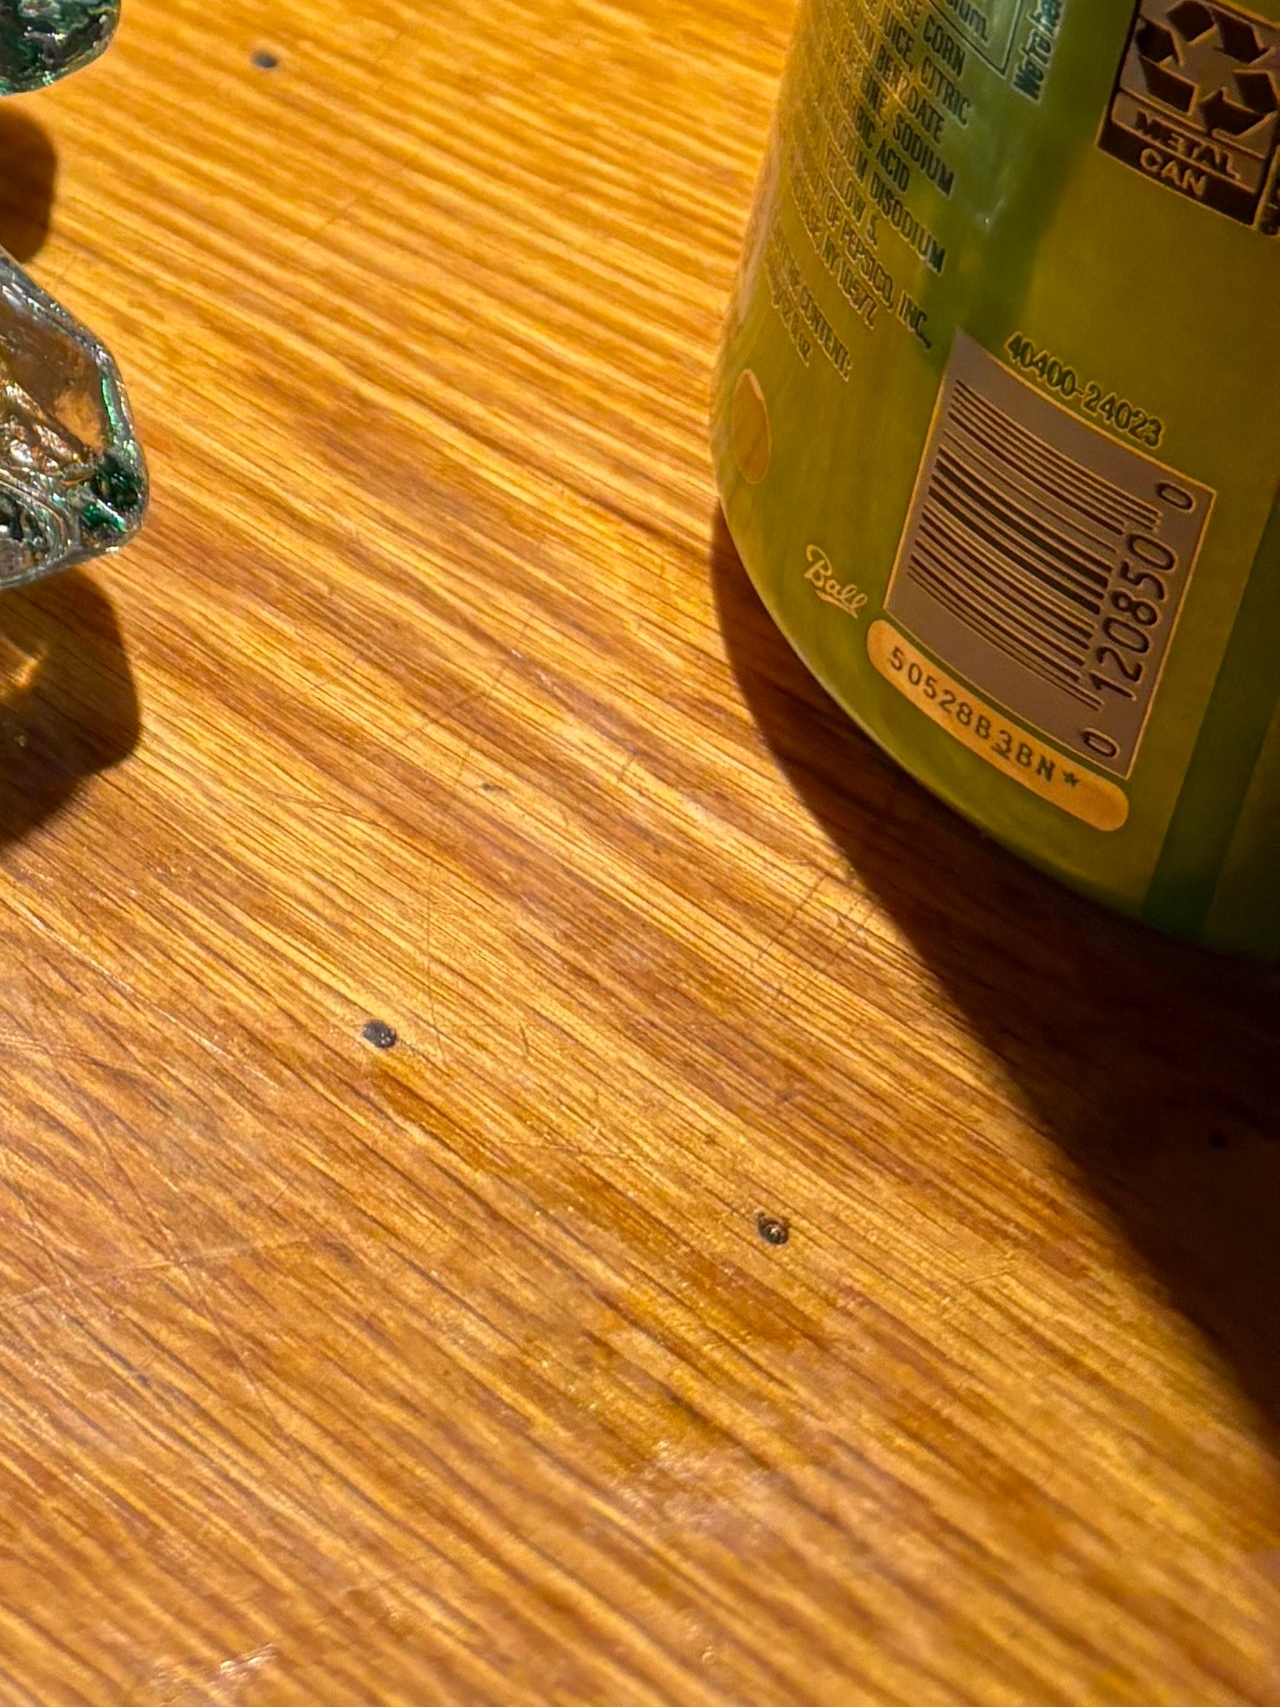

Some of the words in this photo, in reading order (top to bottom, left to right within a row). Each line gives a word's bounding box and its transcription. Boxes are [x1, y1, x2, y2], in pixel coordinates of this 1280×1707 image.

[923, 14, 966, 77] CORN
[920, 56, 971, 126] CITRIC
[875, 139, 910, 192] ACID
[892, 113, 955, 197] SODIUM
[1135, 107, 1240, 182] METAL
[1140, 147, 1208, 199] CAN
[869, 173, 946, 273] DISODIUM
[1006, 333, 1164, 449] 40400-24023
[1157, 483, 1194, 513] 0
[804, 544, 869, 618] Ball
[1083, 533, 1178, 701] 120850
[1083, 730, 1120, 759] 0
